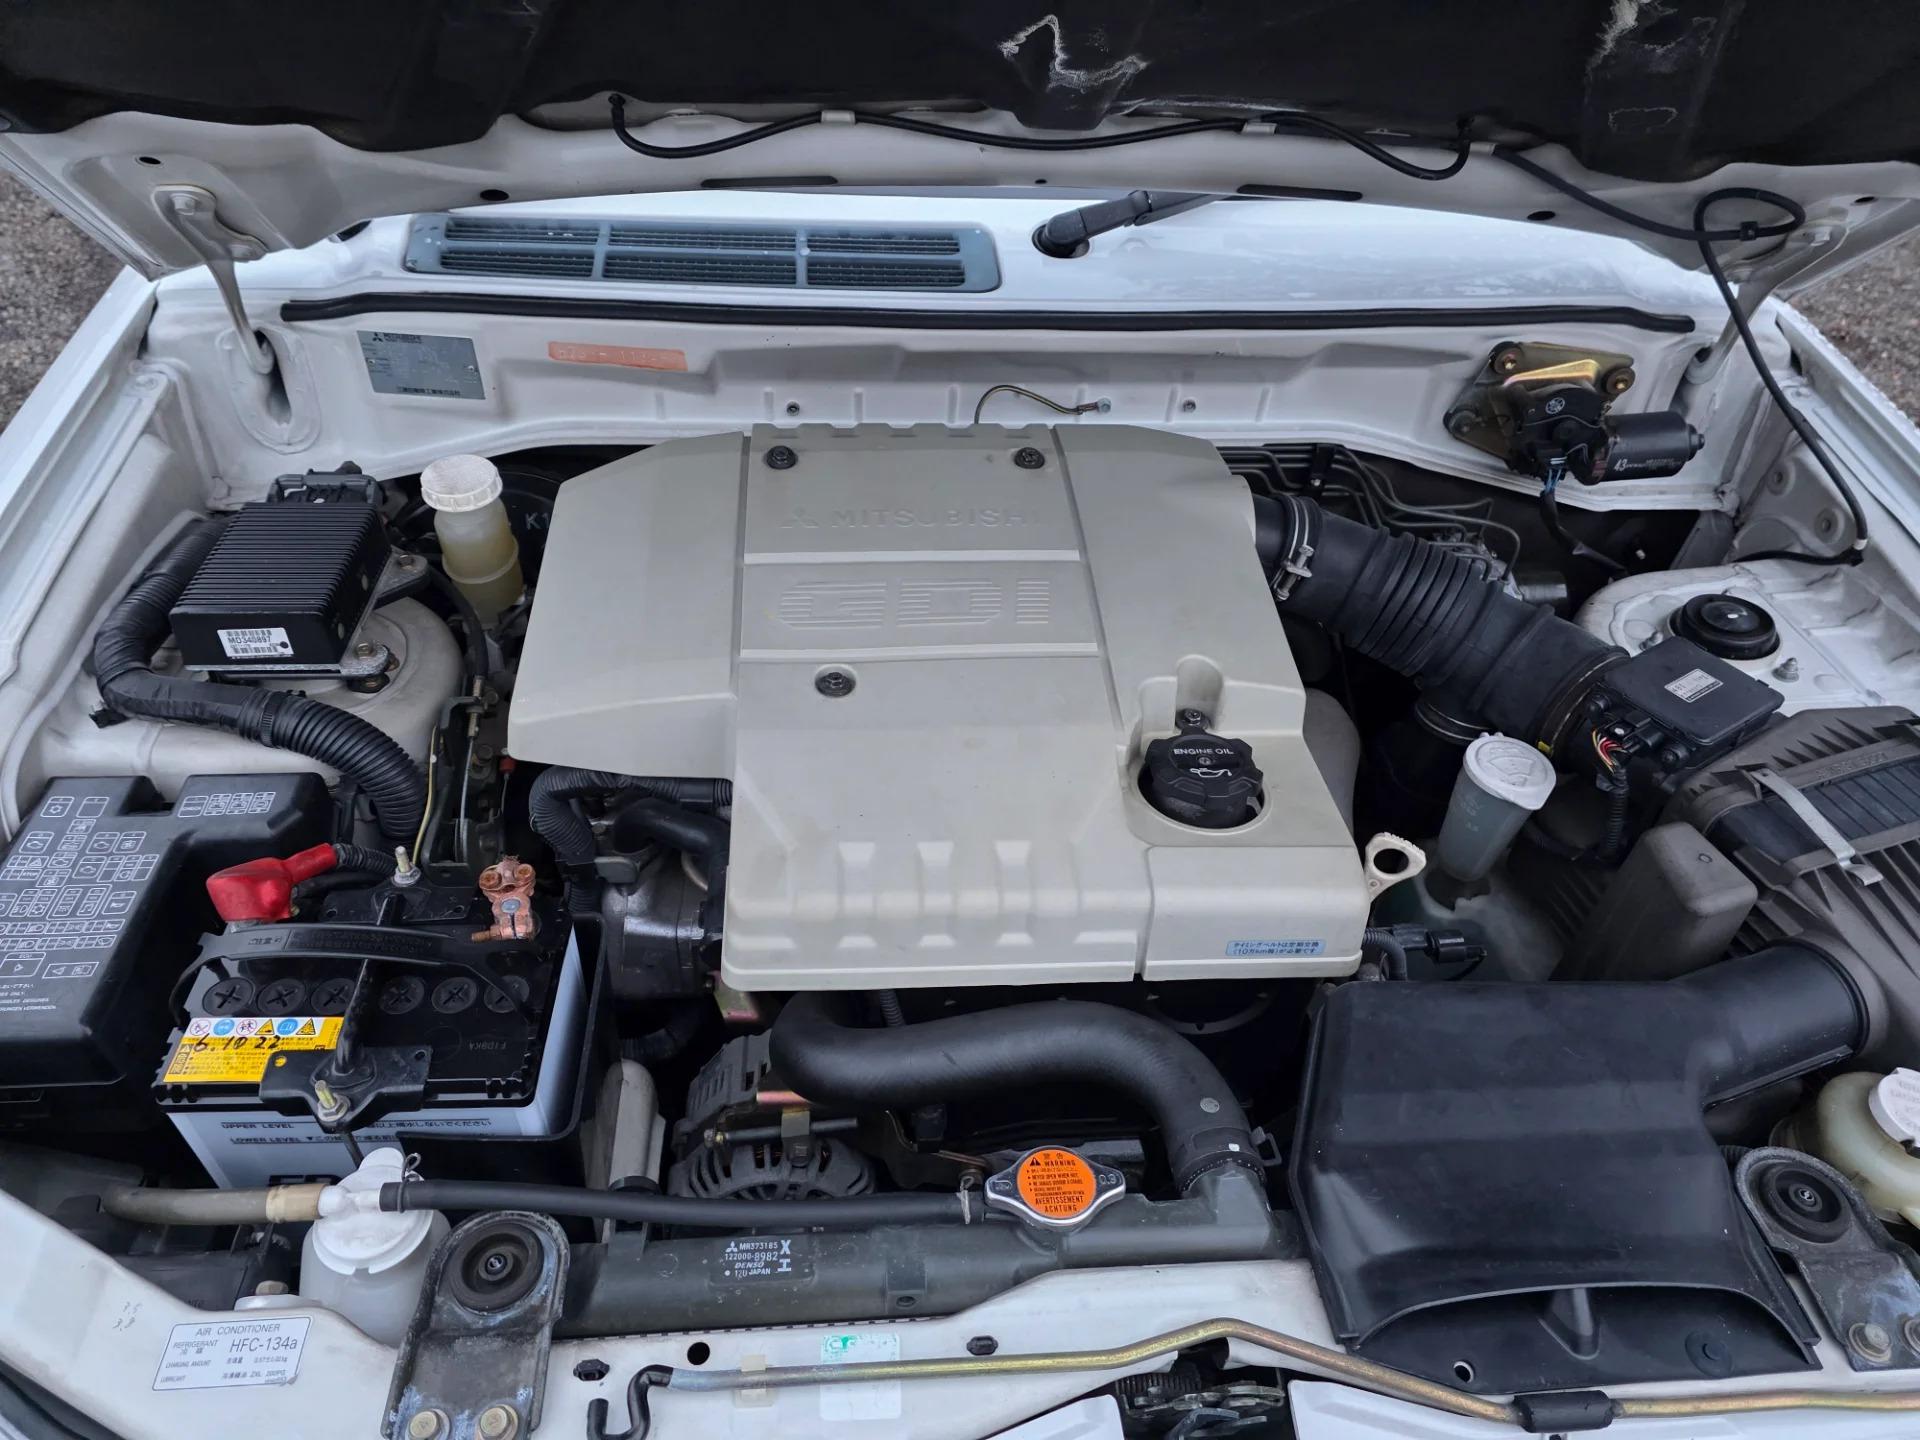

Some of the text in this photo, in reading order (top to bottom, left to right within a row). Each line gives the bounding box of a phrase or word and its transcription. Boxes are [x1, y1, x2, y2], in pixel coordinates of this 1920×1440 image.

[778, 578, 1050, 630] GDI
[1035, 1195, 1084, 1205] AVERTISSEMENT
[1044, 1204, 1077, 1213] ACHTUNG
[725, 1252, 778, 1261] 122000-8982
[735, 1261, 765, 1269] DENSO
[196, 1323, 281, 1337] AIR CONDITIONER
[173, 1340, 219, 1348] REFRIGERANT
[229, 1335, 298, 1353] HFC-134a
